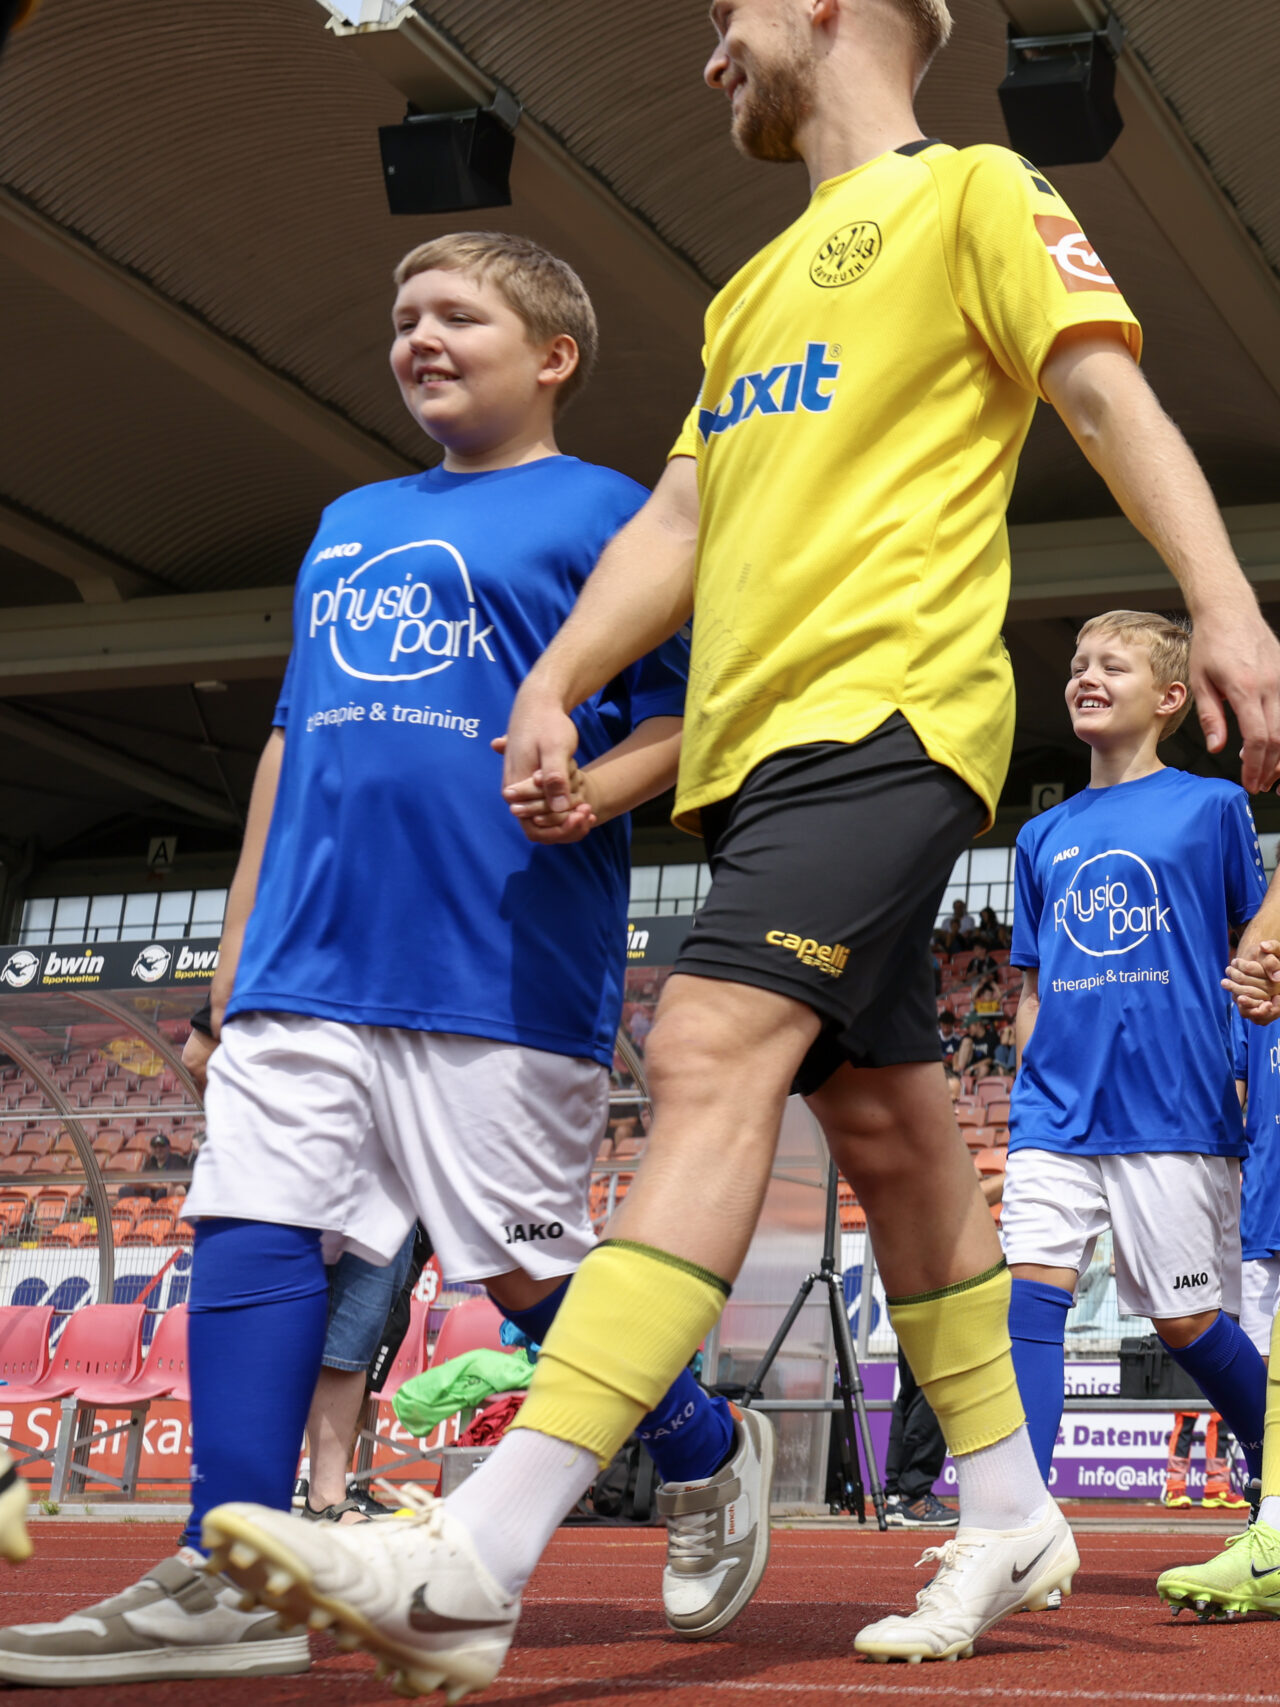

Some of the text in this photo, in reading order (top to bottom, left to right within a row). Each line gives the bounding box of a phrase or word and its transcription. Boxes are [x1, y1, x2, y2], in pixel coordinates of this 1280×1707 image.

[309, 571, 432, 638] physio
[389, 606, 497, 663] park
[368, 702, 387, 721] &
[392, 704, 480, 738] training
[1038, 786, 1057, 813] C
[152, 841, 169, 863] A
[1052, 845, 1080, 866] JAKO
[1053, 874, 1128, 932] physio
[1109, 897, 1171, 941] park
[626, 923, 649, 950] in
[765, 929, 851, 969] capelli
[43, 948, 105, 975] bwin
[176, 944, 220, 970] bwi
[800, 956, 844, 979] SPORT
[42, 973, 100, 985] Sportwetten
[174, 967, 216, 979] Sportwe
[1052, 968, 1170, 993] therapie & training
[505, 1222, 564, 1244] JAKO
[1172, 1271, 1209, 1290] JAKO
[642, 1401, 695, 1440] JAKO
